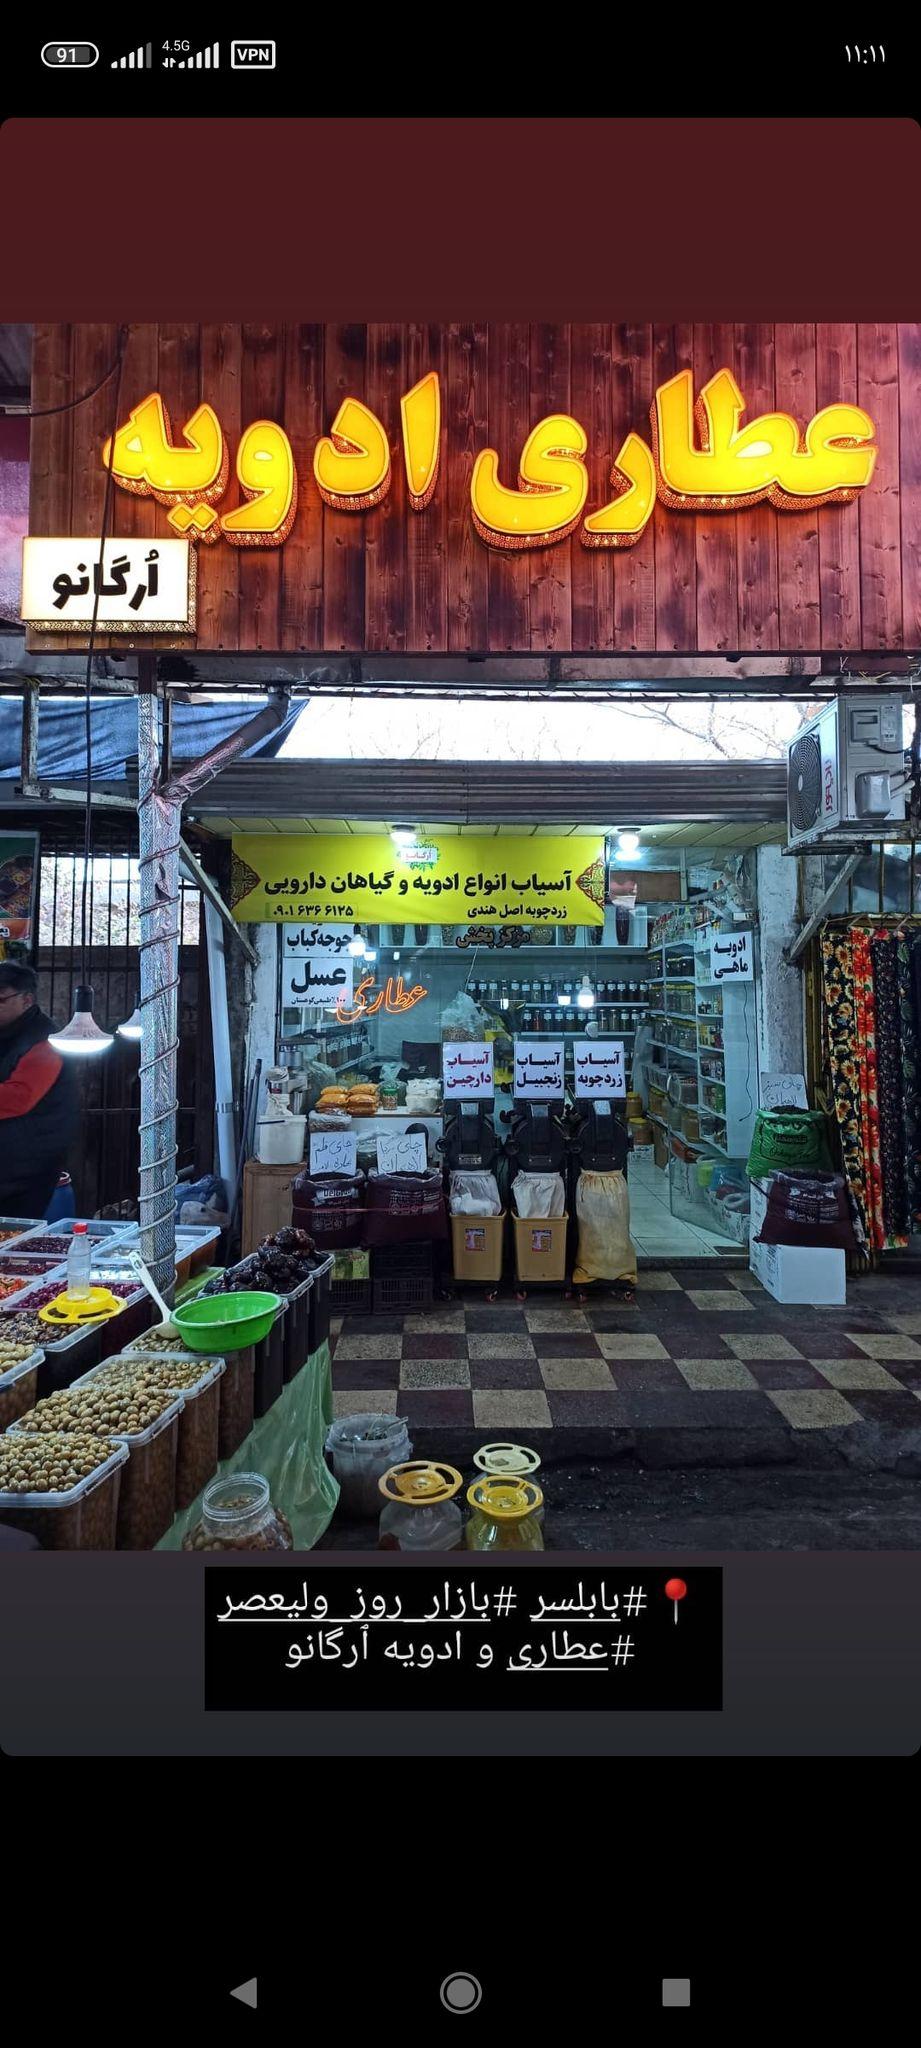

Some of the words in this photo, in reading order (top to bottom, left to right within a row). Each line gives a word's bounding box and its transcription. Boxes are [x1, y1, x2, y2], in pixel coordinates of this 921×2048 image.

[103, 371, 440, 540] ادویه
[470, 367, 878, 543] عطاری
[264, 871, 326, 895] دارویی
[330, 870, 395, 895] گیاهان
[398, 878, 408, 896] و
[413, 872, 459, 896] ادویه
[464, 872, 506, 897] انواع
[511, 870, 572, 896] آسیاب
[467, 905, 497, 918] هندی
[499, 904, 523, 918] اصل
[525, 905, 567, 920] زردچوبه
[713, 935, 746, 958] ادویه
[290, 960, 347, 994] عسل
[714, 957, 749, 979] ماهی
[336, 976, 428, 1024] عطاری
[446, 1051, 491, 1068] آسیاب
[516, 1051, 562, 1068] آسیاب
[576, 1050, 621, 1068] آسیاب
[446, 1072, 492, 1089] دارچین
[516, 1072, 562, 1089] زنجبیل
